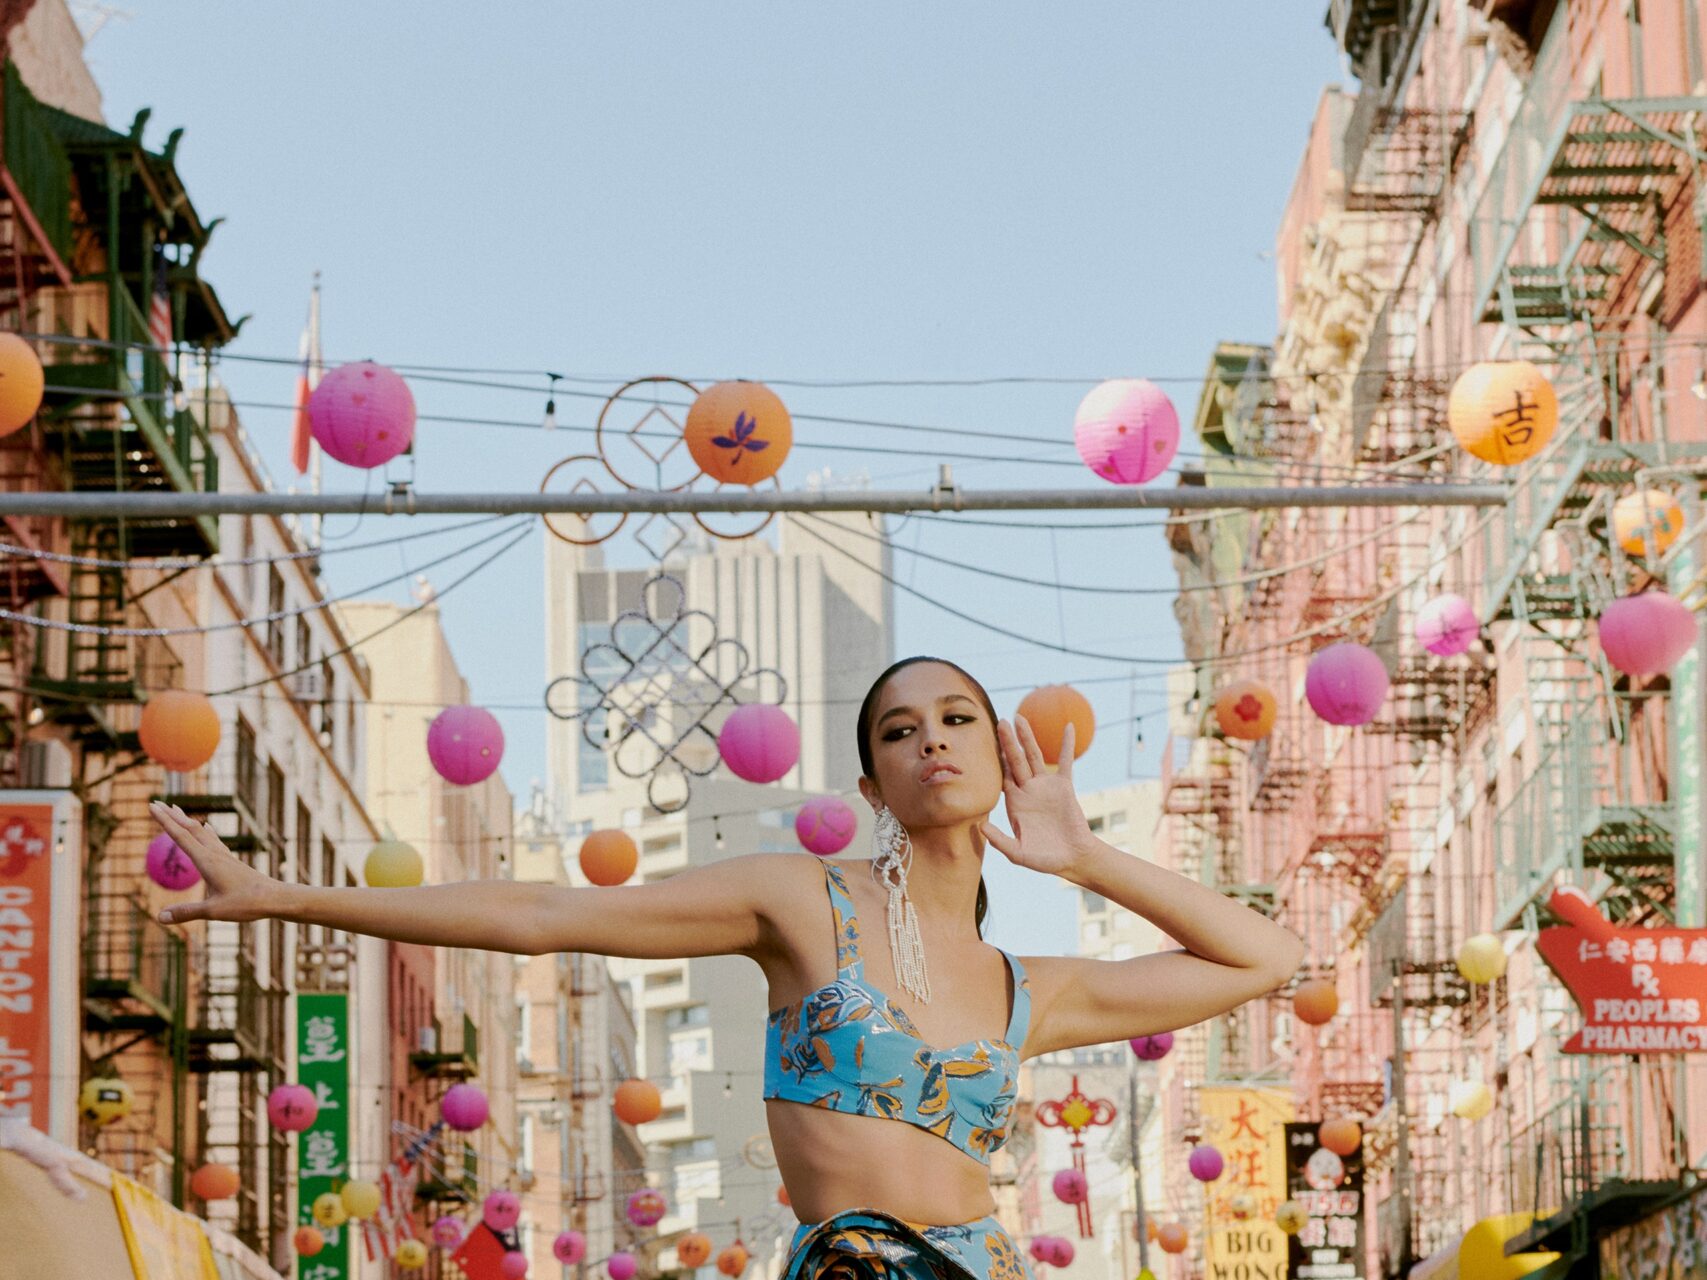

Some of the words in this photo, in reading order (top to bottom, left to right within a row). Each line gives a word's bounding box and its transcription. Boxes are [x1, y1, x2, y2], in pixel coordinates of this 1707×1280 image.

[1493, 390, 1539, 446] 吉
[1594, 998, 1700, 1023] PEOPLES
[1227, 1231, 1272, 1254] BIG
